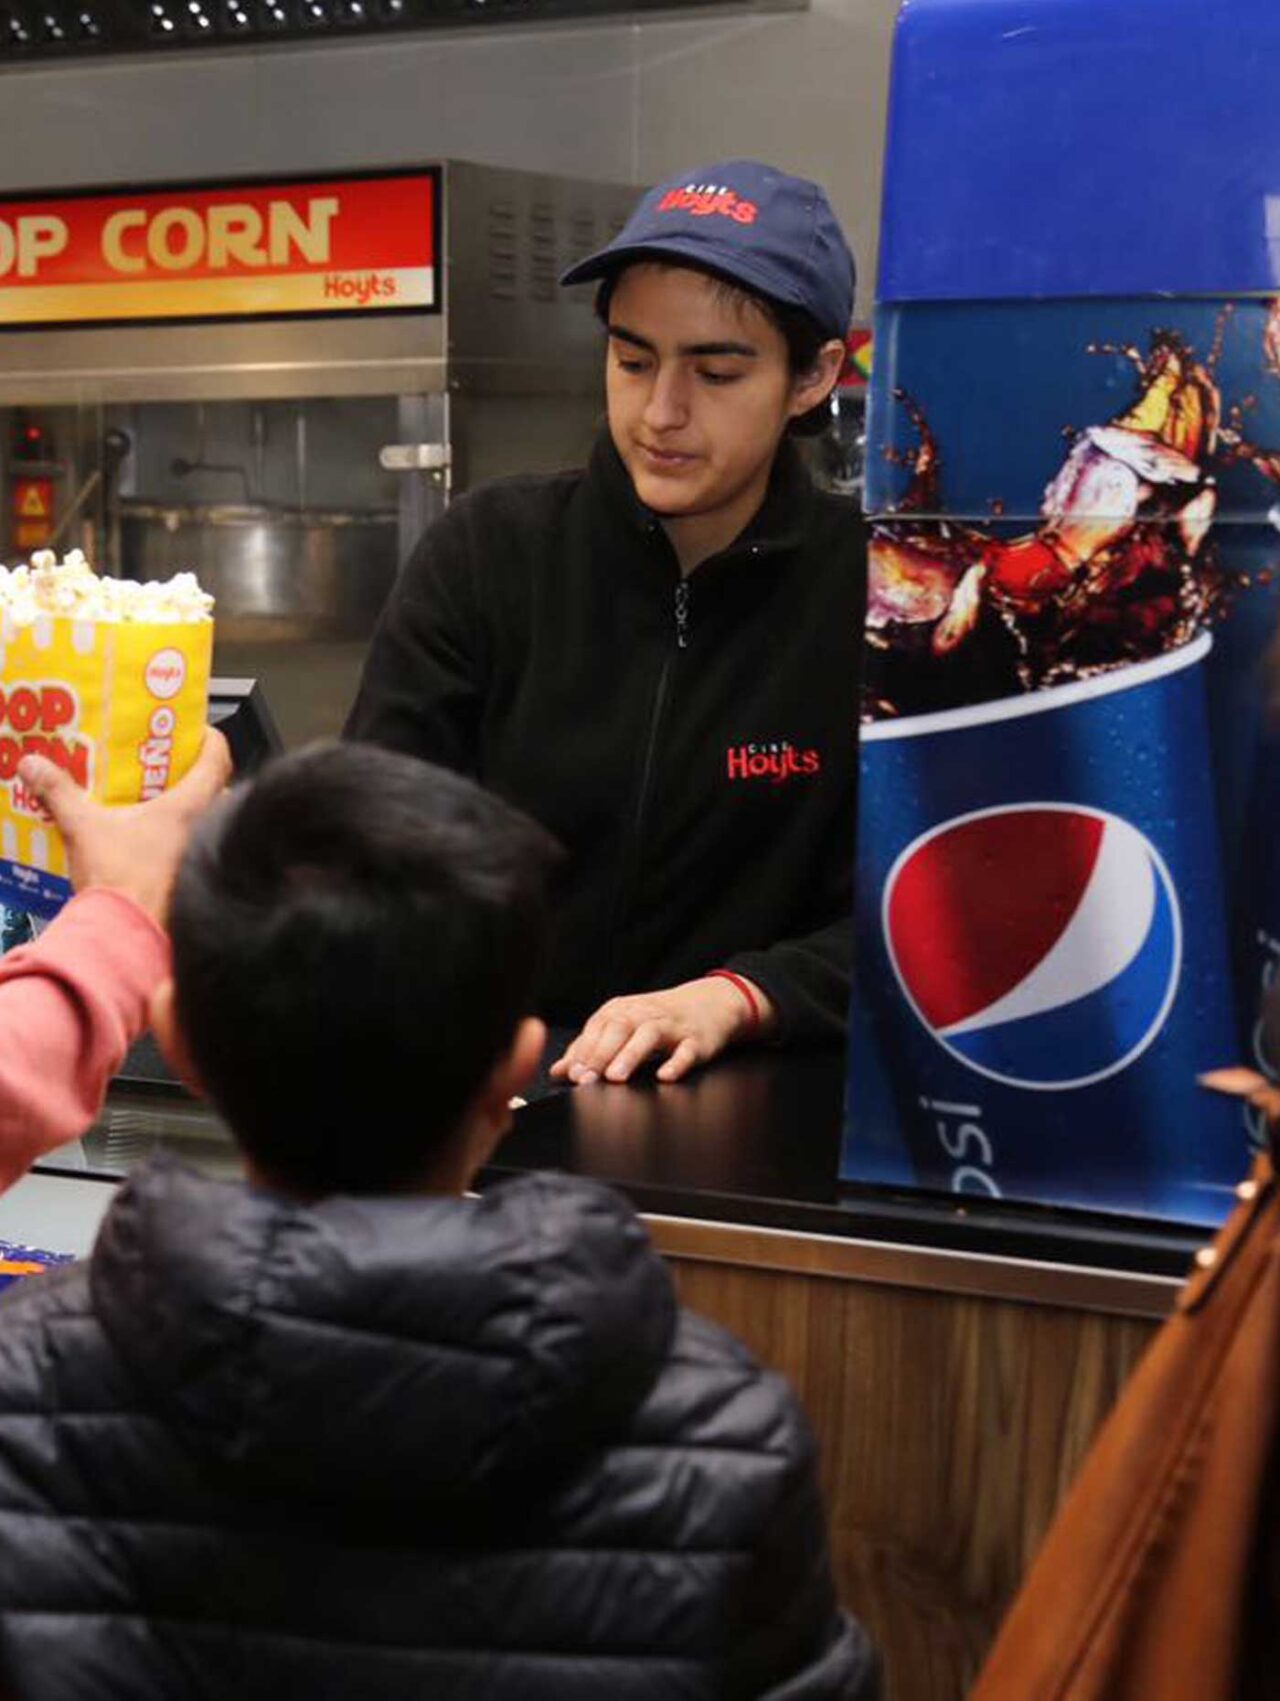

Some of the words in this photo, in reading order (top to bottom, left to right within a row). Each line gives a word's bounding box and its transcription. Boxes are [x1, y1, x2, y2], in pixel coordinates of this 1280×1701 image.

[100, 198, 339, 272] CORN
[322, 274, 396, 304] Hoyts
[727, 745, 819, 782] Hoyts
